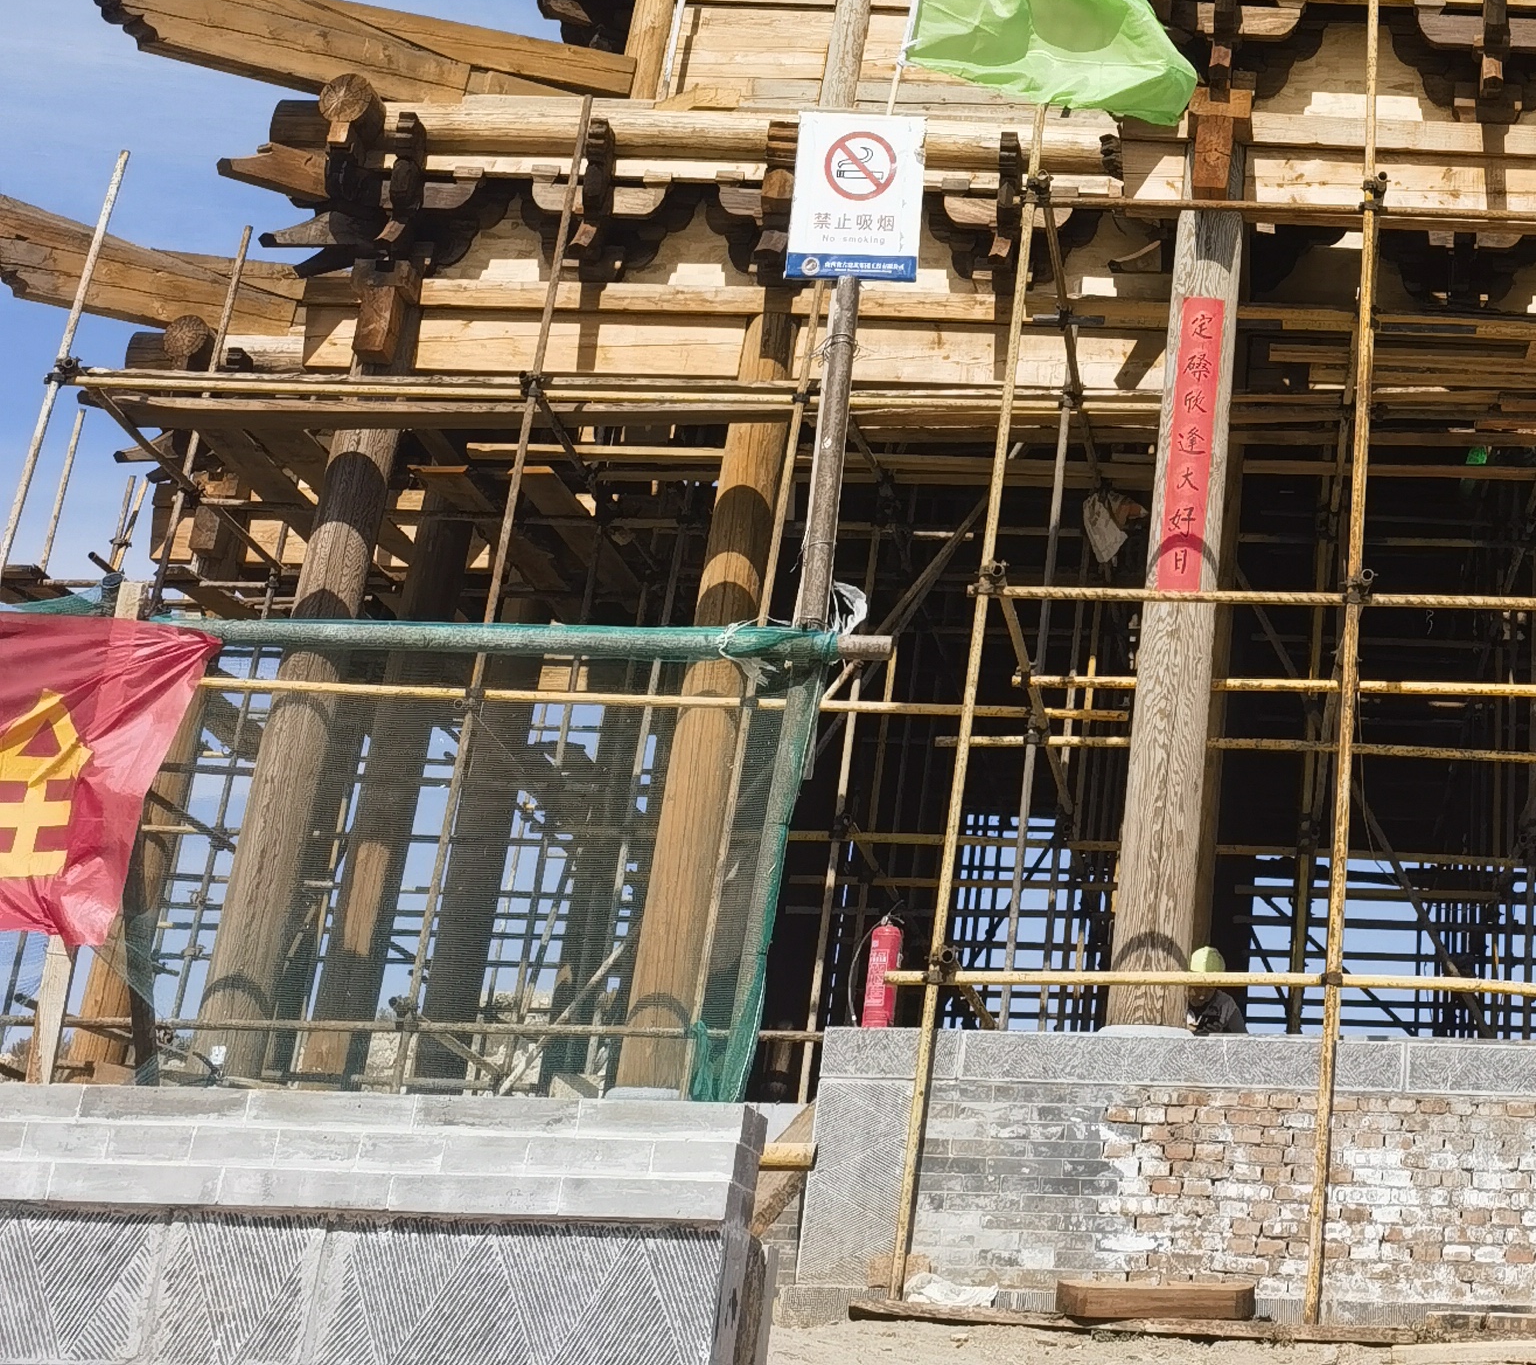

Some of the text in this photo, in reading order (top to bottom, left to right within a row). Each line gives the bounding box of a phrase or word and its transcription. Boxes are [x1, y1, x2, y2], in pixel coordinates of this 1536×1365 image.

[813, 212, 895, 232] 禁止吸烟
[822, 234, 886, 245] No smoking
